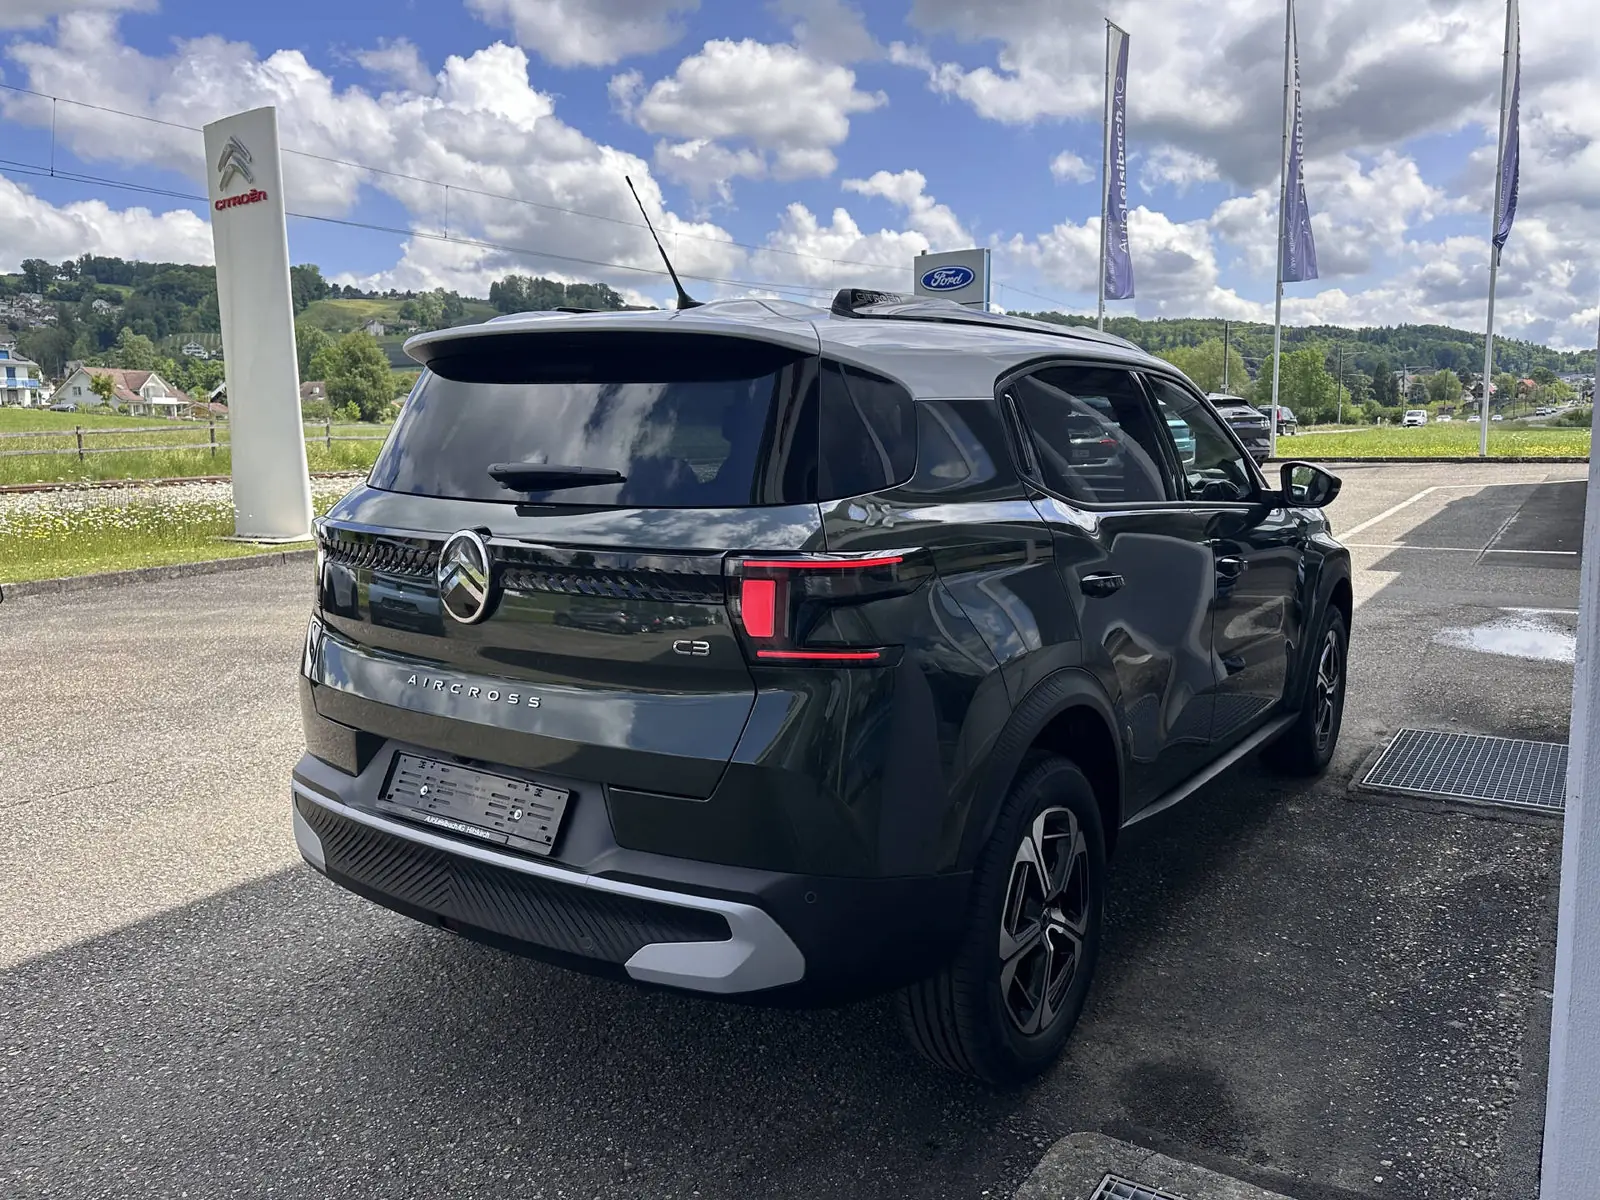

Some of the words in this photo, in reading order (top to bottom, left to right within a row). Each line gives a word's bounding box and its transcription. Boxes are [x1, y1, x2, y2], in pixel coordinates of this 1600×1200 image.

[931, 270, 963, 286] Ford
[672, 639, 710, 656] C3
[407, 673, 542, 708] AIRCROSS
